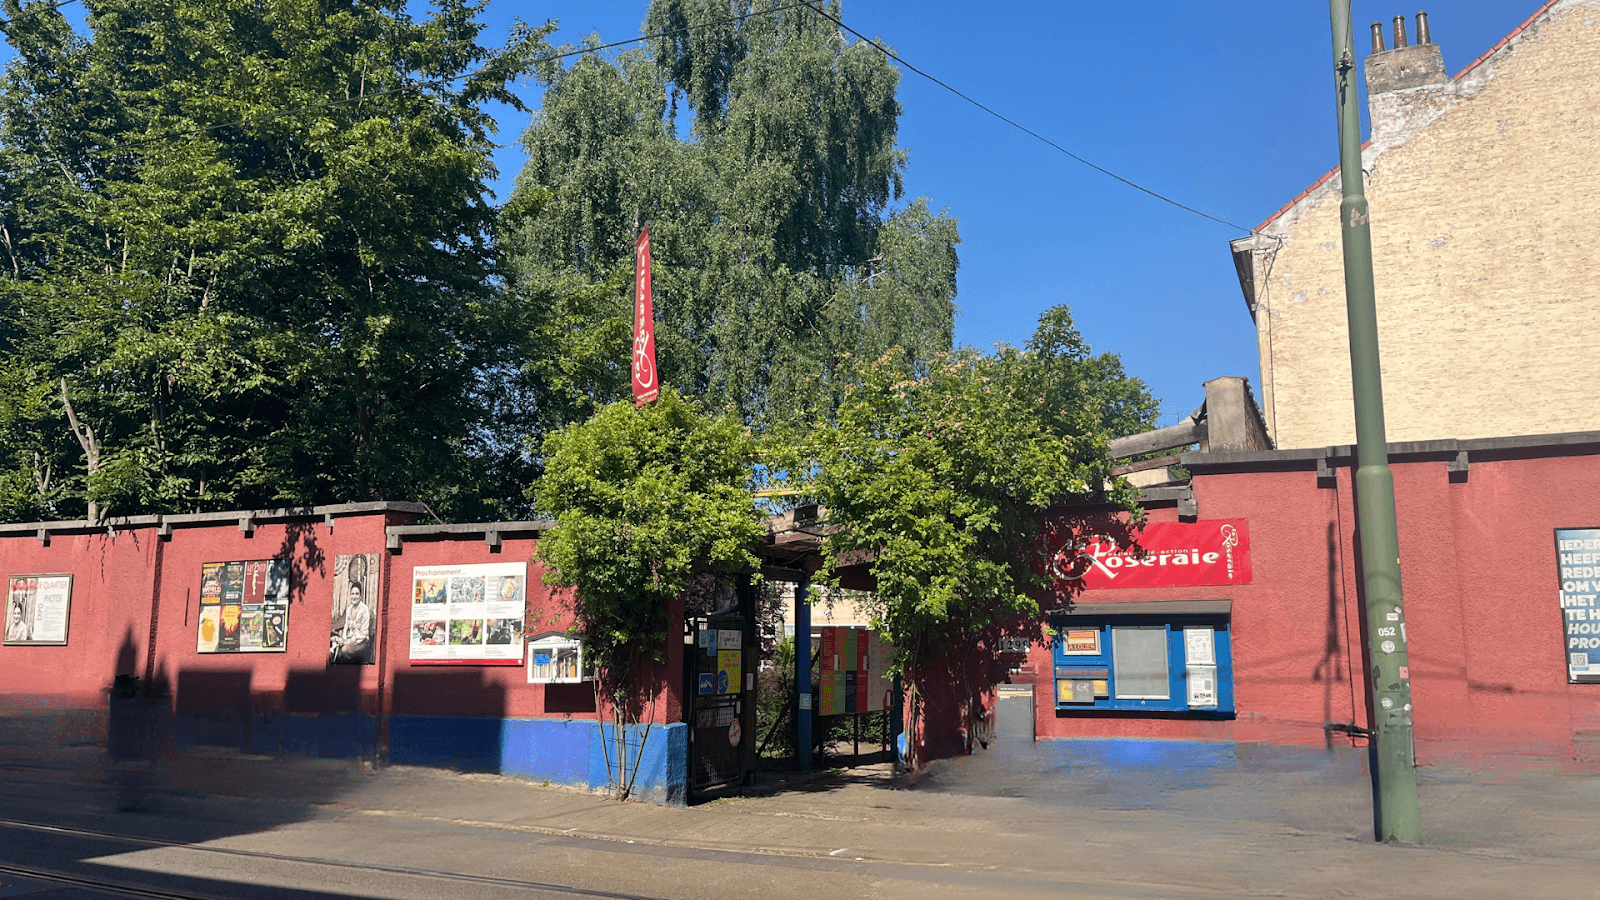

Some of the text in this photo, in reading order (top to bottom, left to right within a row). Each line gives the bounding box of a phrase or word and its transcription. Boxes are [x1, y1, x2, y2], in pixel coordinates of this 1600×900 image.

[1053, 534, 1220, 579] Roseraie
[415, 569, 466, 577] Prochainement...
[43, 580, 68, 591] QUARTIER
[1564, 581, 1589, 593] OM
[1565, 595, 1596, 607] HET
[1566, 609, 1586, 621] TE
[1378, 626, 1396, 637] 052
